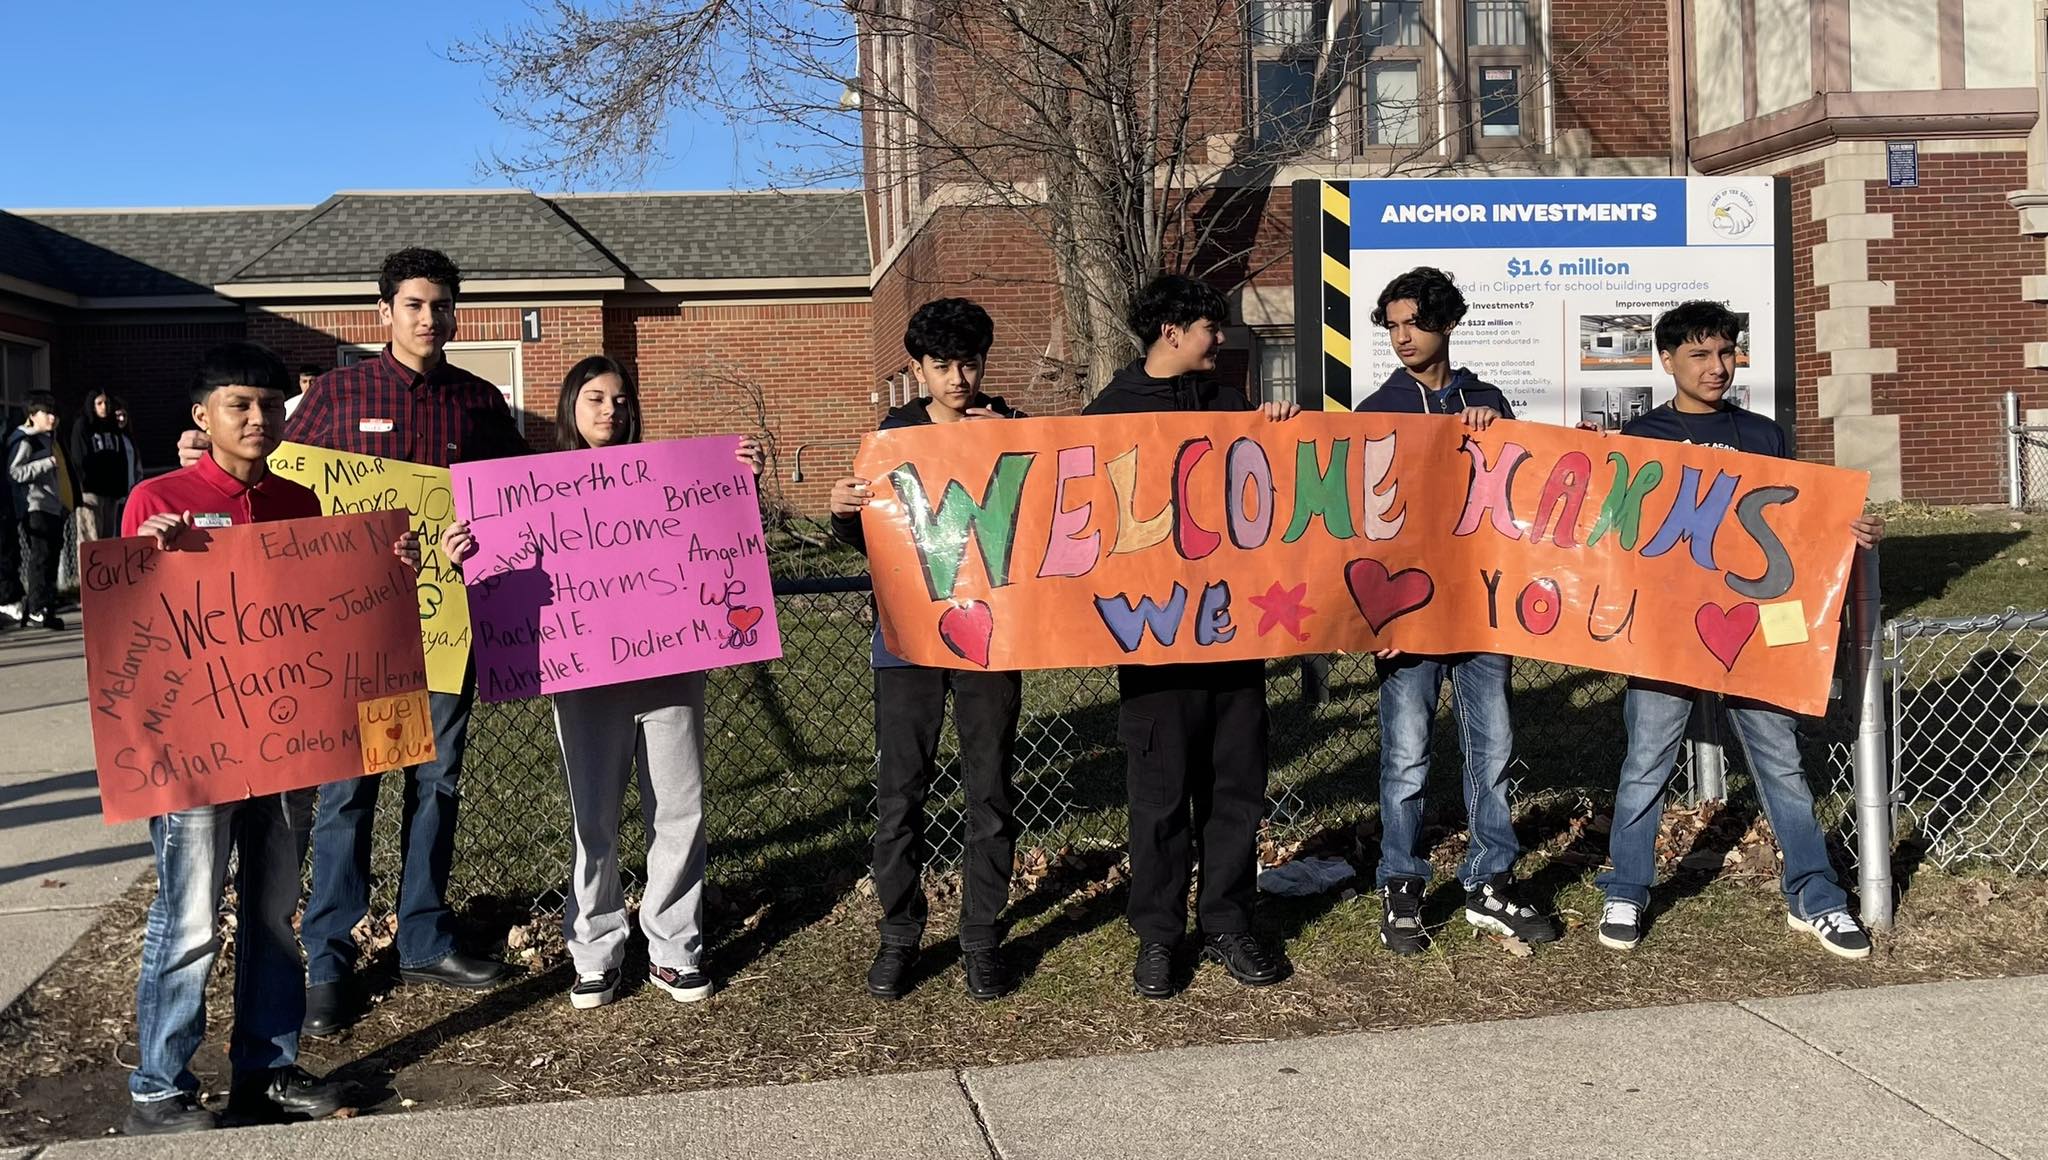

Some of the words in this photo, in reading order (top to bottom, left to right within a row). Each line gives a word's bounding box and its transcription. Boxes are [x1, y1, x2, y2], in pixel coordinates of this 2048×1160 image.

[1381, 203, 1487, 223] ANCHOR
[1493, 202, 1657, 223] INVESTMENTS
[1479, 281, 1491, 293] in
[1493, 280, 1541, 294] Clippert
[1544, 280, 1561, 292] for
[1564, 280, 1603, 292] school
[1606, 280, 1651, 294] building
[1655, 280, 1709, 294] upgrades
[1507, 257, 1553, 278] $1.6
[1559, 257, 1630, 276] million
[1467, 319, 1486, 327] $132
[1487, 319, 1514, 327] million
[1472, 301, 1535, 311] Investments?
[1615, 299, 1680, 309] Improvements
[525, 311, 538, 339] 1
[1510, 399, 1528, 407] $1.6
[467, 462, 616, 523] Limberth
[527, 506, 686, 557] Welcome
[886, 430, 1408, 604] WELCOME
[1451, 433, 1800, 600] HARMS
[160, 571, 326, 660] Welcome
[1094, 577, 1238, 654] WE
[1480, 567, 1638, 645] YOU
[479, 611, 566, 650] Rachel
[610, 623, 688, 665] Didier
[192, 650, 334, 729] Harms
[259, 725, 336, 764] Caleb
